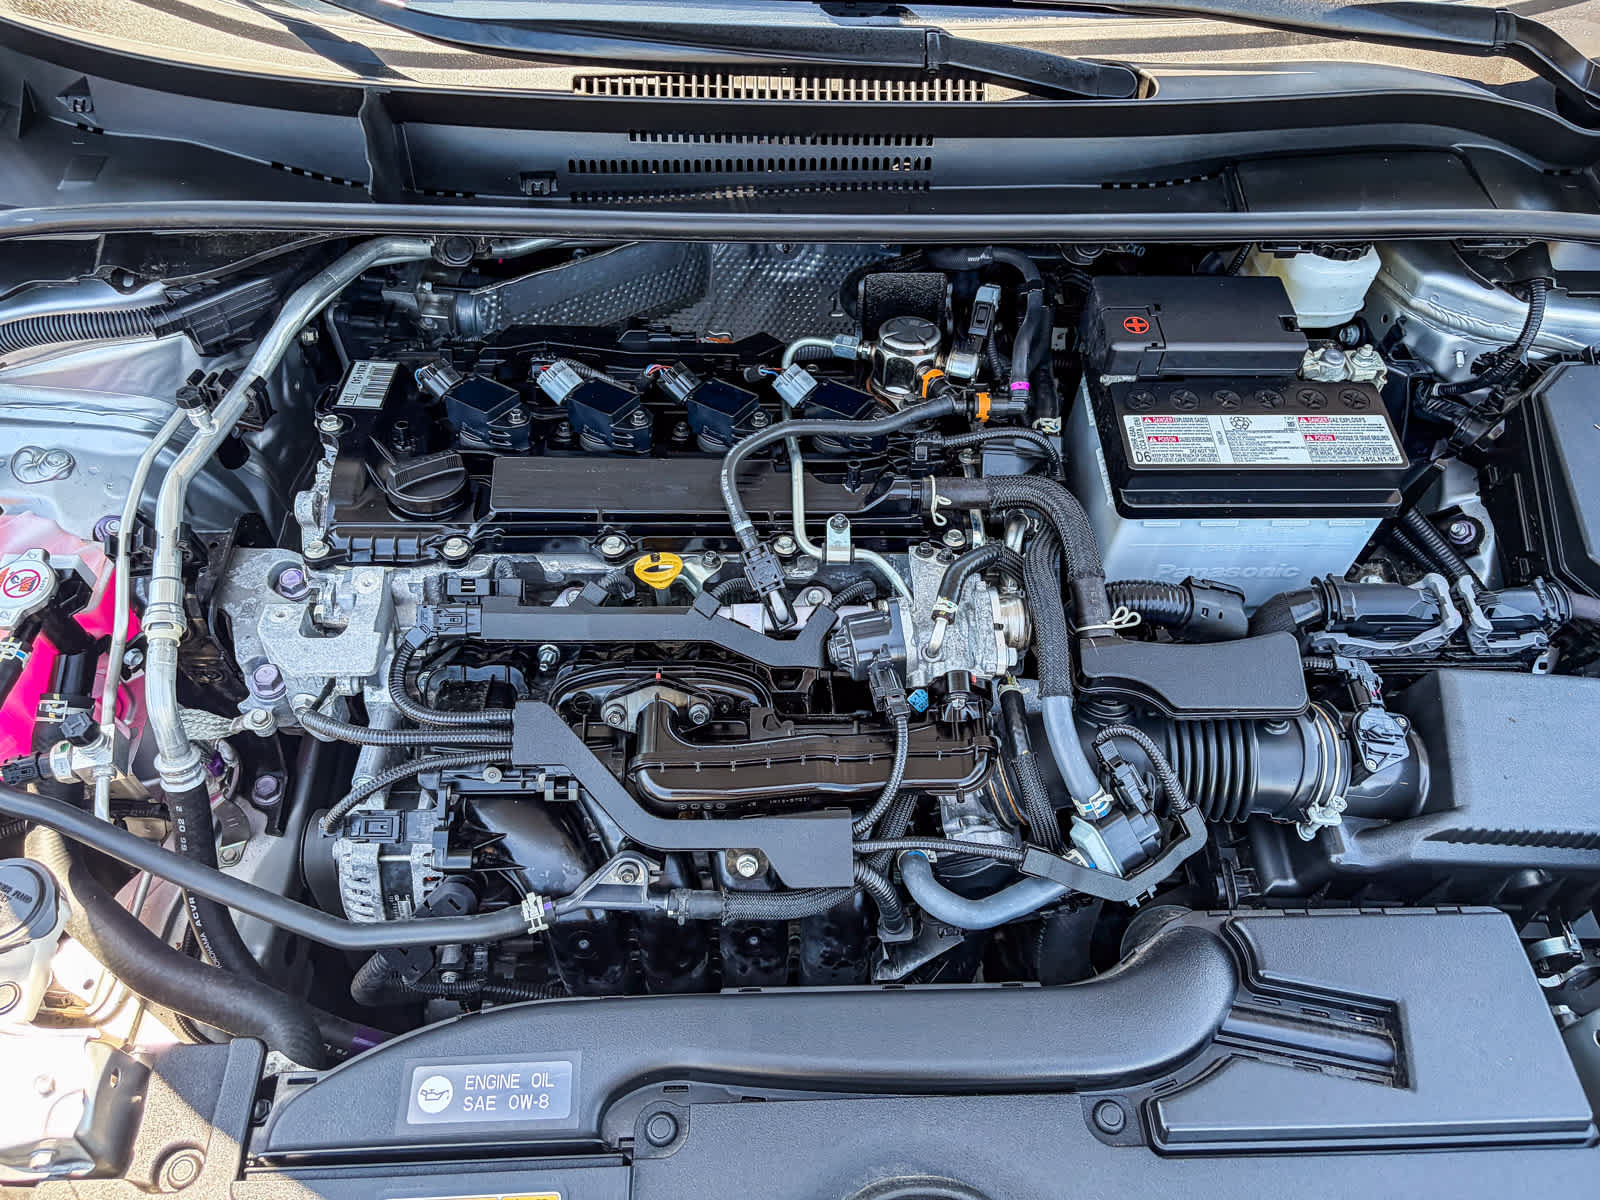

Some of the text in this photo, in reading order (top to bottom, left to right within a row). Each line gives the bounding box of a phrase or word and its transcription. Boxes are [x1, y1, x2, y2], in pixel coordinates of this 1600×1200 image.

[1135, 451, 1152, 463] D6
[1158, 562, 1301, 579] Panasonic
[464, 1072, 555, 1091] ENGINE OIL
[463, 1093, 550, 1112] SAE 0W-8
